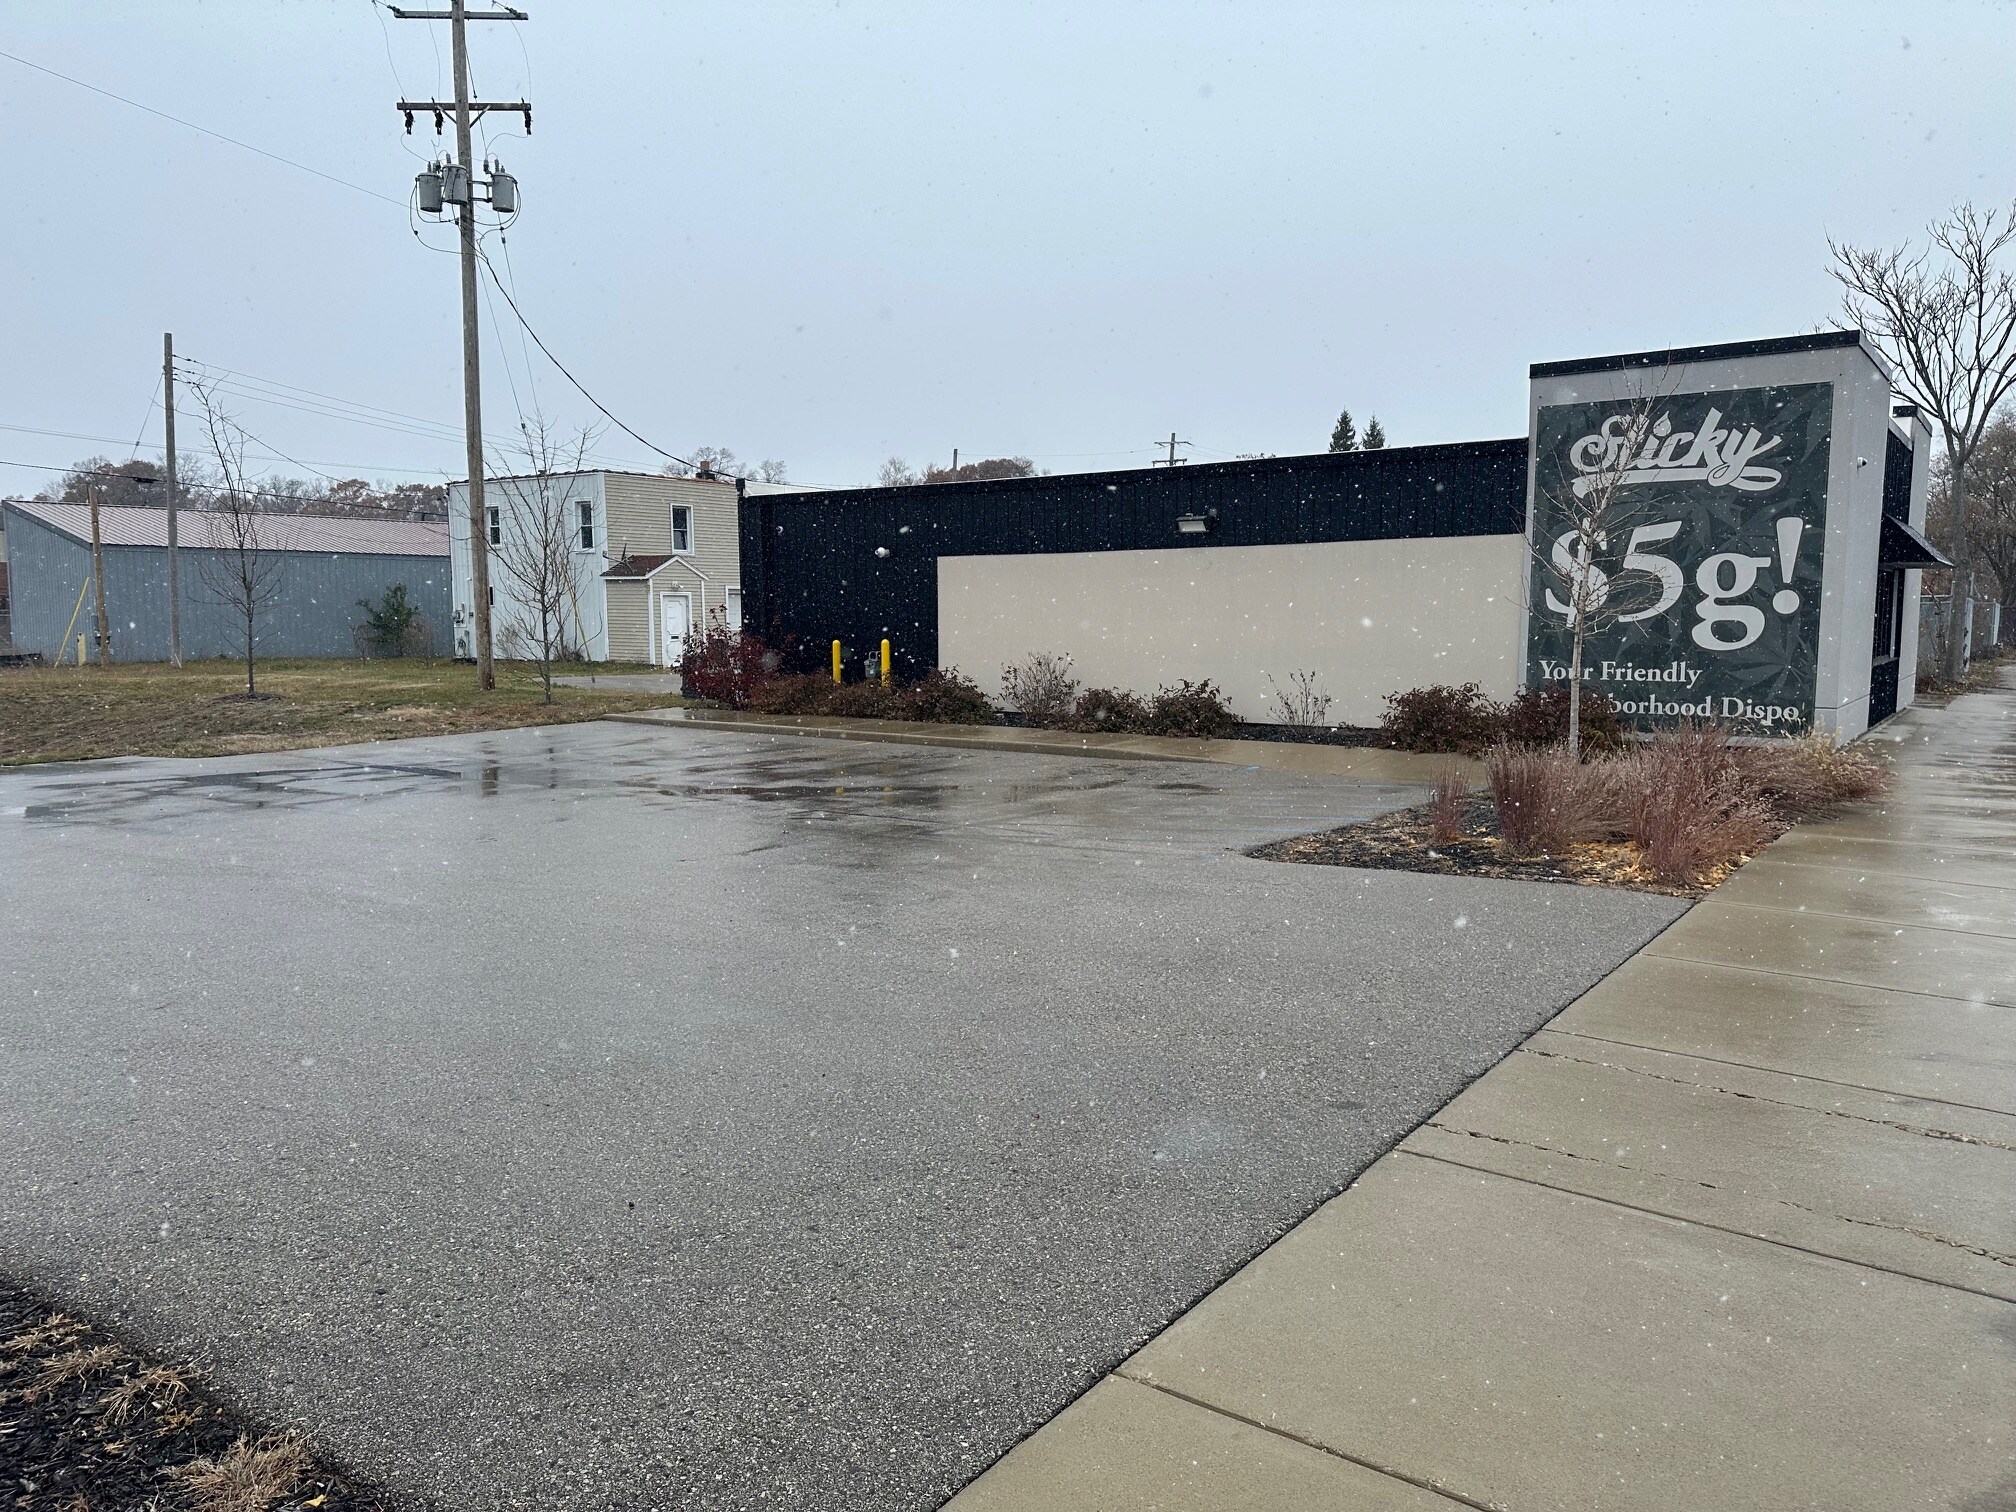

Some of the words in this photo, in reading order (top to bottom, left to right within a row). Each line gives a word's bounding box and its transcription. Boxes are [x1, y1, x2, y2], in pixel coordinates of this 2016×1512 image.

[1570, 407, 1782, 498] Sticky
[1545, 517, 1804, 651] $5g!
[1539, 692, 1711, 717] borhood
[1600, 661, 1702, 689] Friendly
